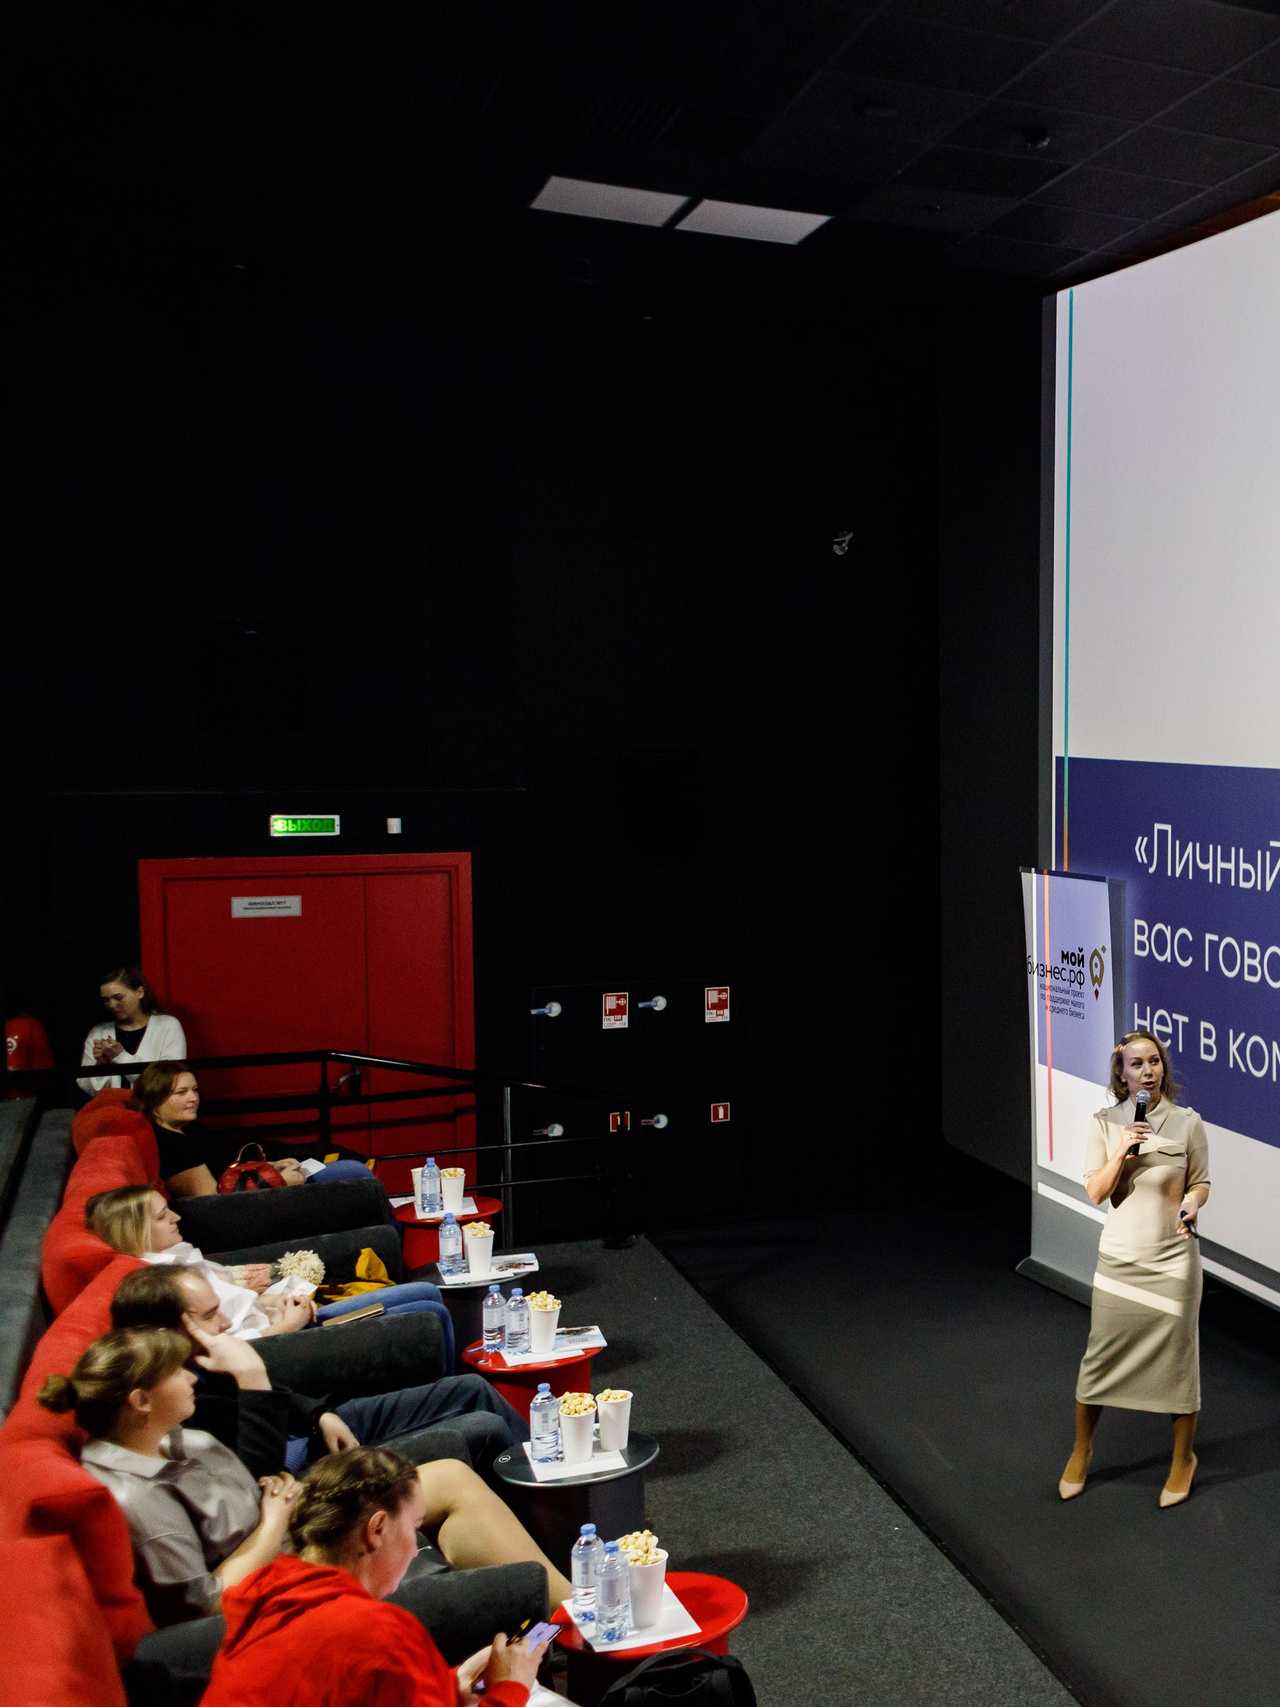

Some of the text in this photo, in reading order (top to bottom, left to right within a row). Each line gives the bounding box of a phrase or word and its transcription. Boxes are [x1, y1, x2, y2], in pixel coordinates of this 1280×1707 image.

[277, 819, 334, 832] ВЫХОД
[1061, 947, 1085, 968] мой
[1134, 919, 1193, 967] вас
[1027, 955, 1085, 990] бизнес.рф
[1134, 1003, 1190, 1053] нет
[1200, 1021, 1217, 1062] в
